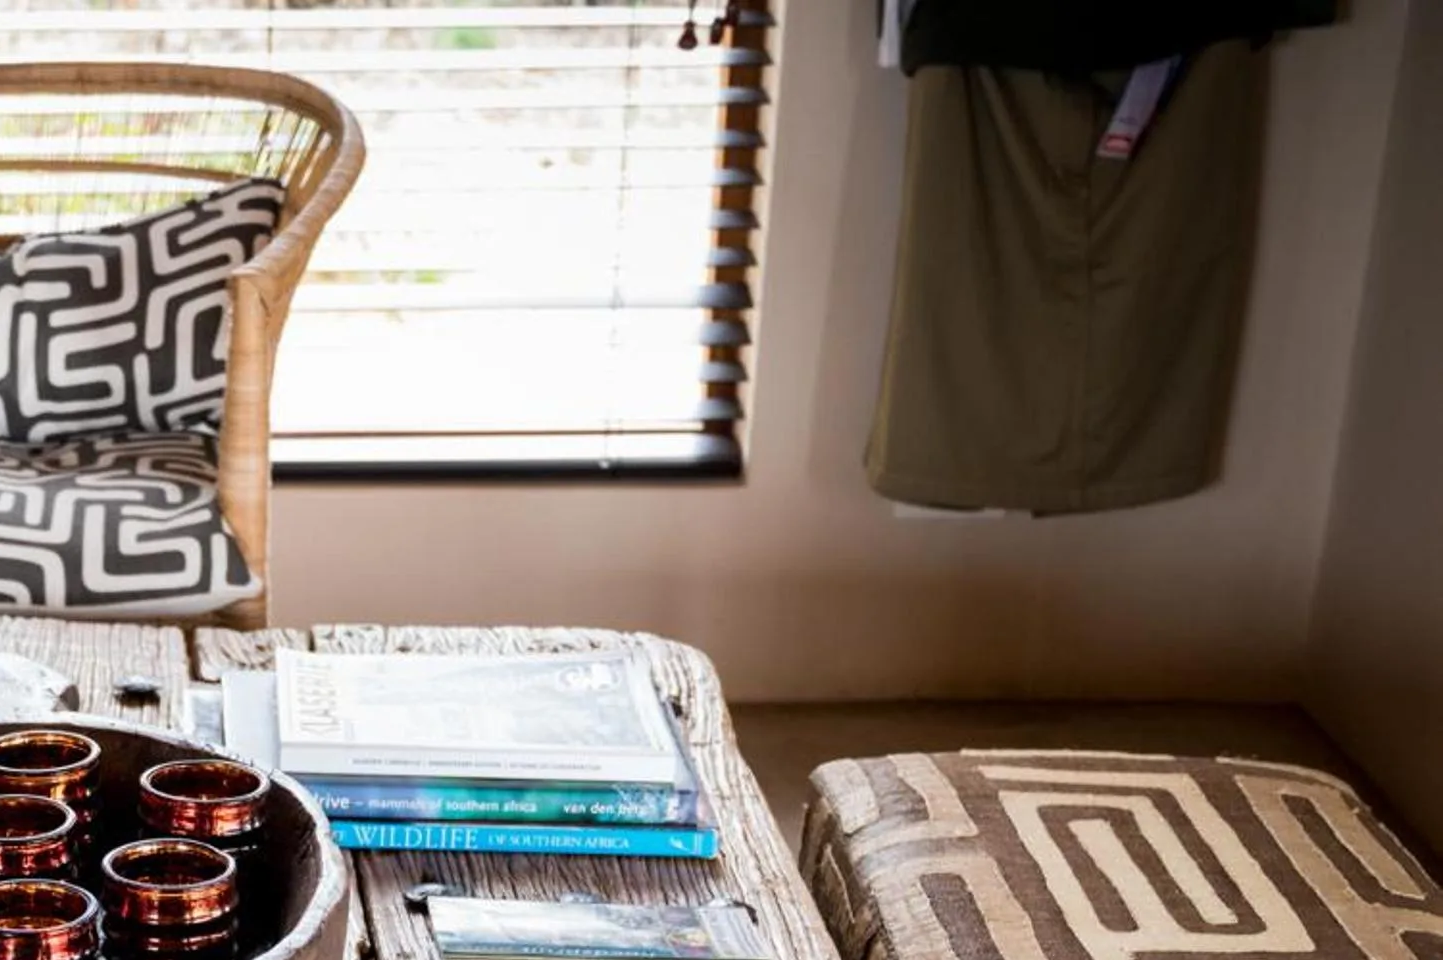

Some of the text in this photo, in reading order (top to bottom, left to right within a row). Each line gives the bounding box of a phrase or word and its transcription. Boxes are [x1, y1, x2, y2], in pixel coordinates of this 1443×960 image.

[445, 798, 500, 813] southern
[502, 800, 538, 813] africa
[562, 803, 587, 815] van
[589, 801, 615, 815] den
[352, 824, 479, 850] WILDLIFE
[488, 833, 506, 845] OF
[508, 833, 583, 849] SOUTHERN
[584, 837, 631, 850] AFRICA
